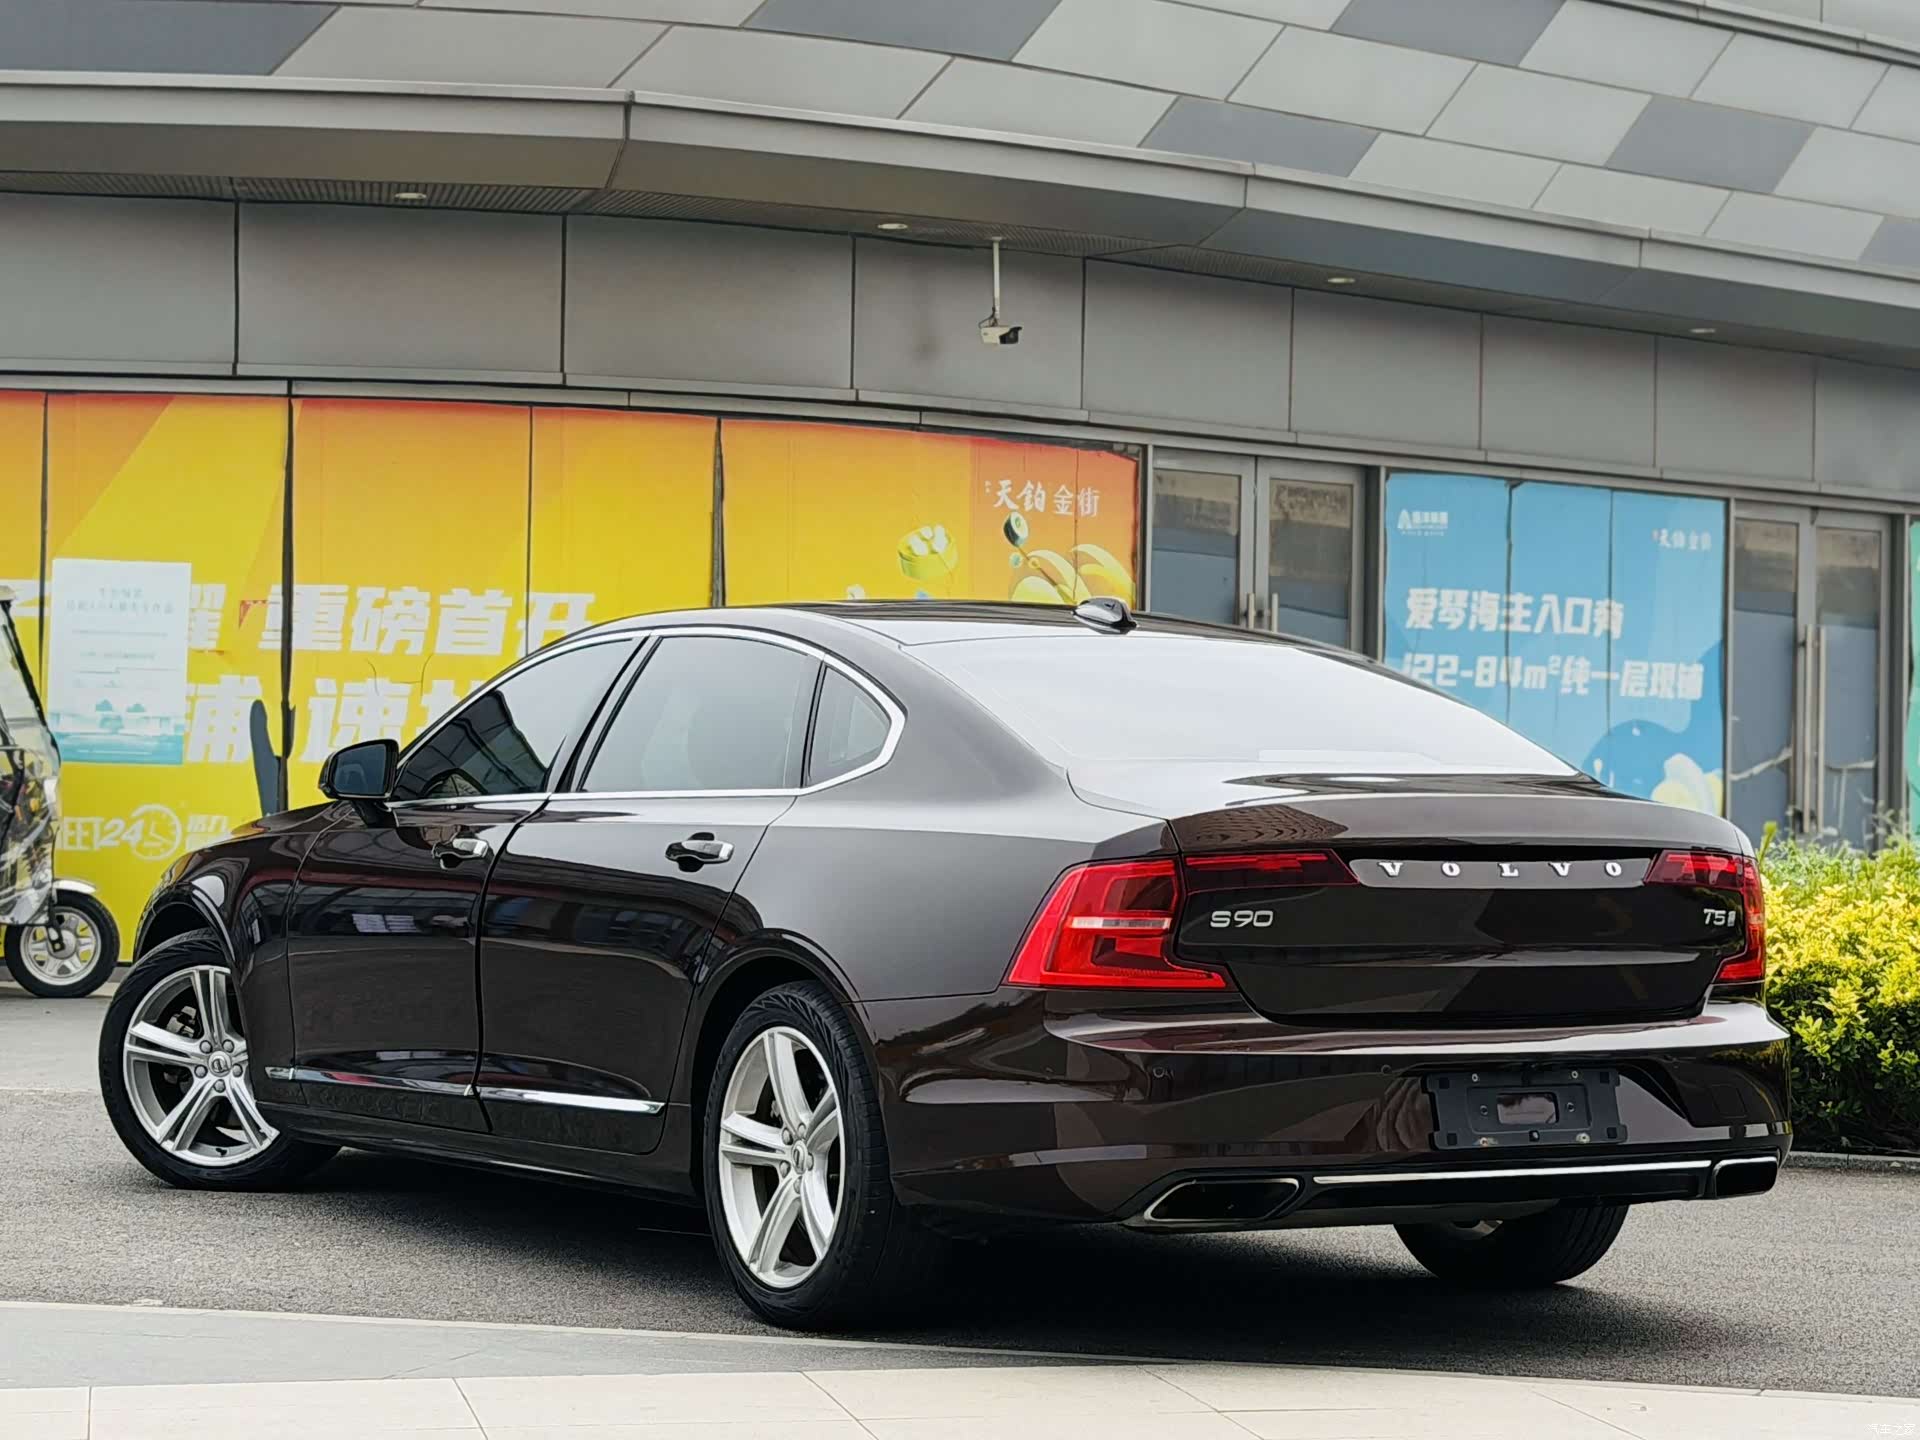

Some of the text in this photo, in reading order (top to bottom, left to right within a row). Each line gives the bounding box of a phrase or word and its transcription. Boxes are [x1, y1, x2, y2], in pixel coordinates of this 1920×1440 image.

[257, 584, 599, 660] 重磅首开
[1378, 860, 1623, 878] VOLVO
[1210, 909, 1274, 928] S90
[1703, 908, 1727, 926] T5
